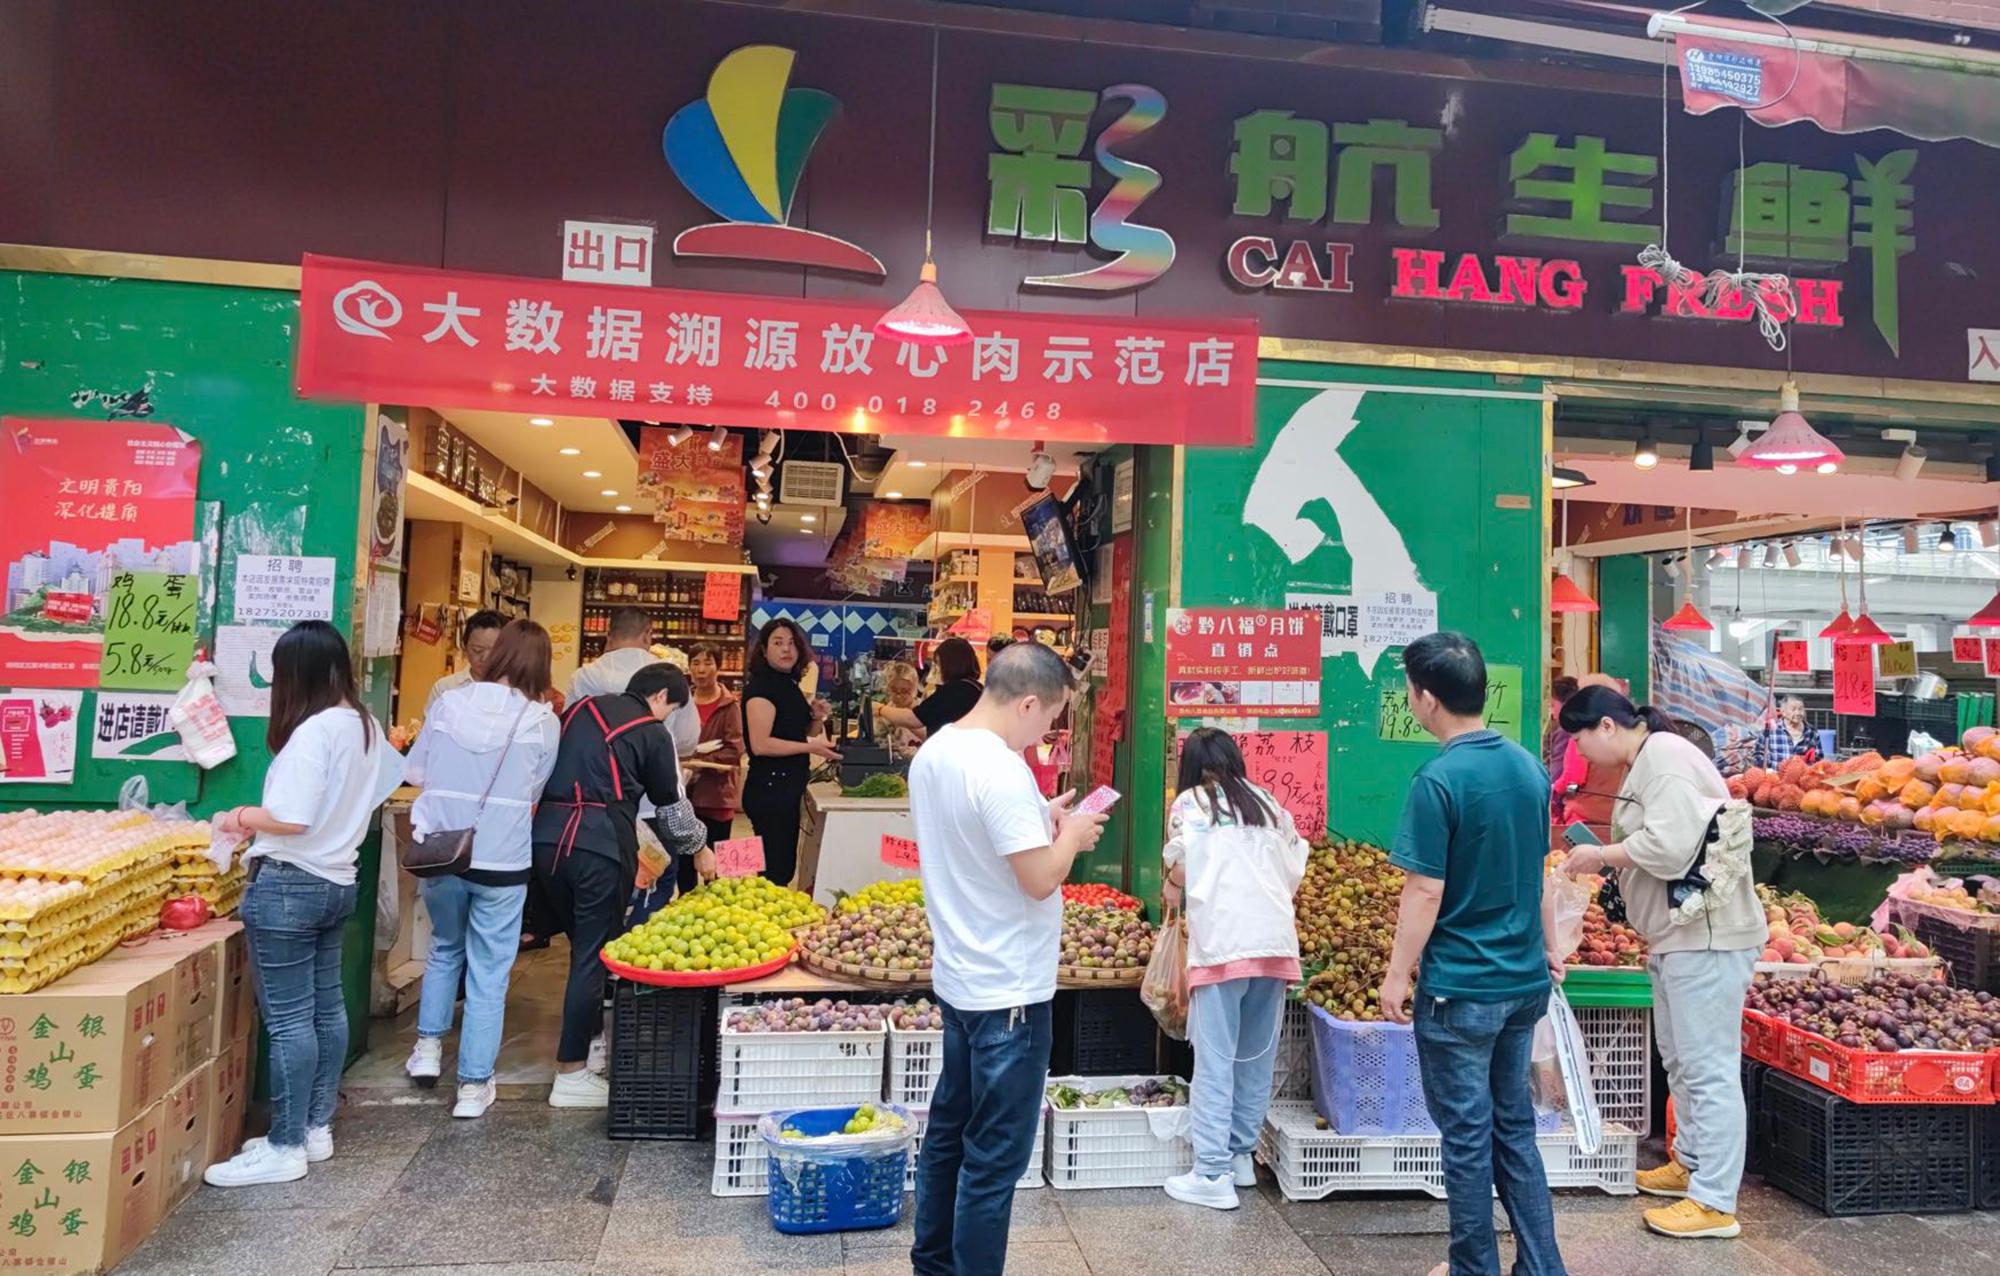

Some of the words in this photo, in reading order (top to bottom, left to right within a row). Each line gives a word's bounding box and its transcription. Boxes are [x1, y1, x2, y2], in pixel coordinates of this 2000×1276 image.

[568, 230, 648, 273] 出口
[1227, 236, 1354, 293] CAI
[1391, 247, 1588, 311] HANG
[422, 292, 1235, 387] 大数据溯源放心肉示范店
[530, 373, 713, 406] 大数据支持
[867, 395, 937, 415] 018
[968, 399, 1062, 420] 2468
[59, 478, 142, 497] 文明贵阳
[54, 501, 138, 522] 深化提质
[267, 558, 303, 573] 招聘
[1385, 592, 1413, 606] 招聘
[239, 608, 329, 619] 18275207303
[1211, 642, 1279, 658] 直销点
